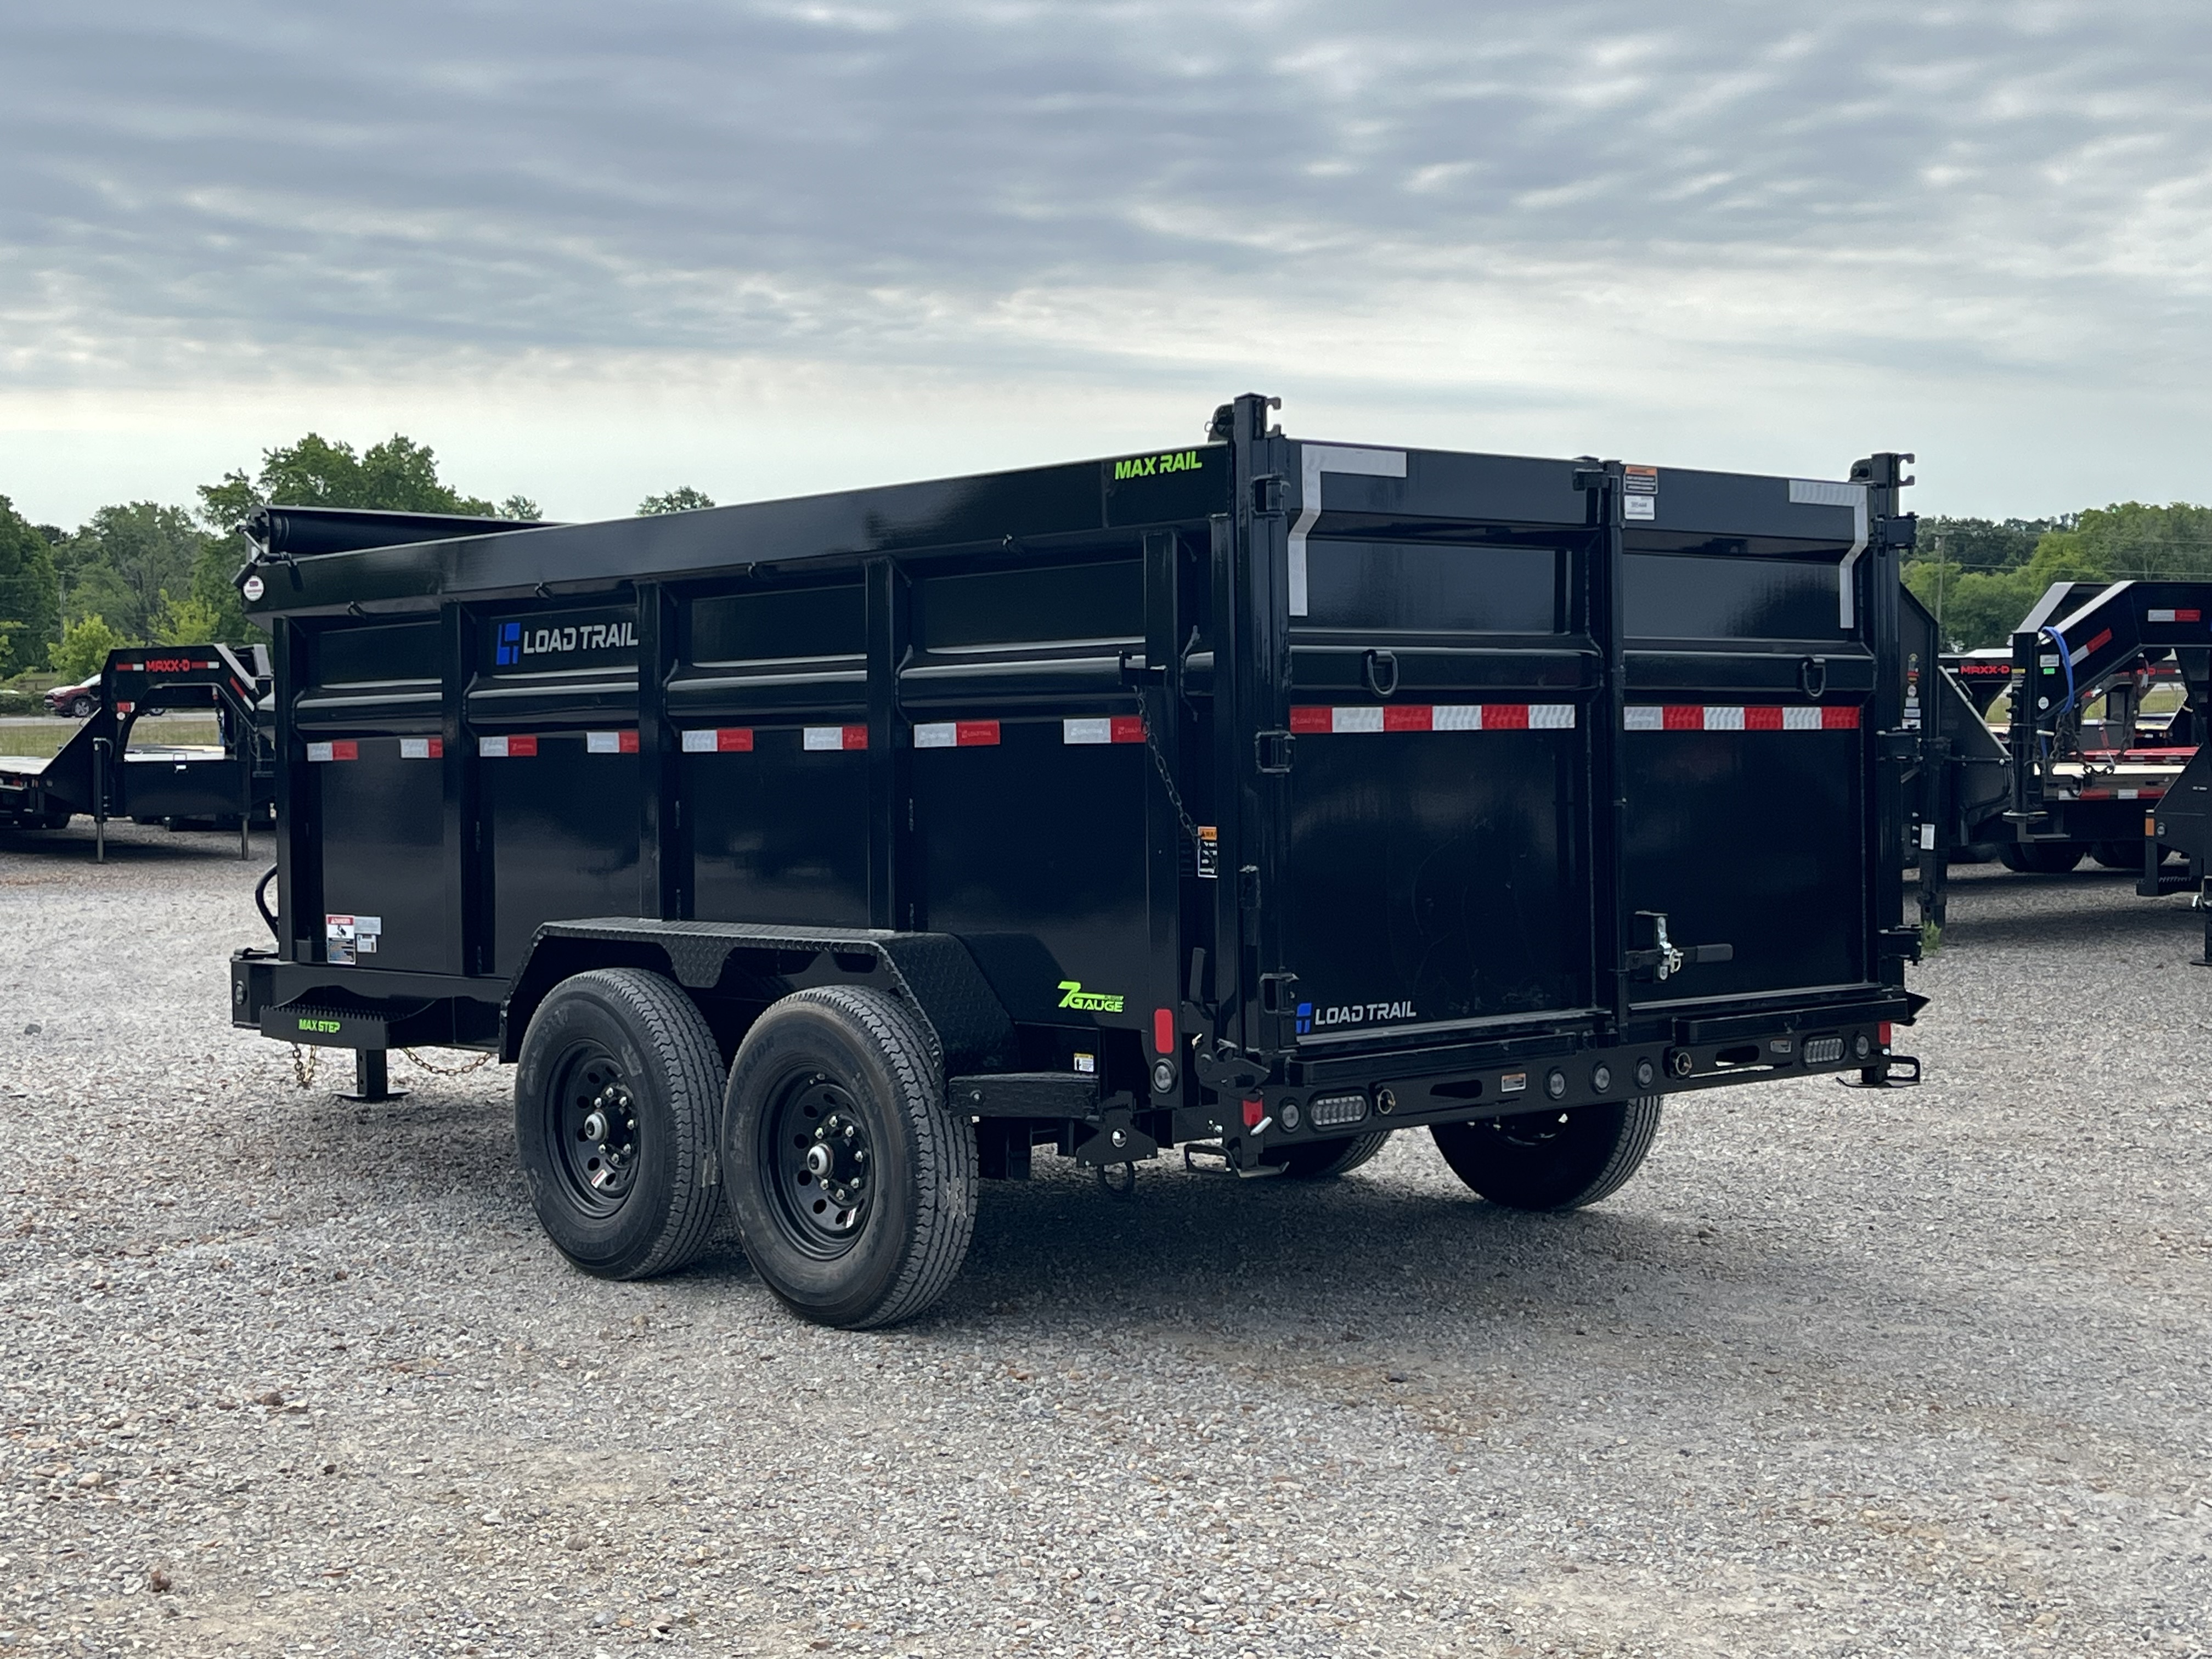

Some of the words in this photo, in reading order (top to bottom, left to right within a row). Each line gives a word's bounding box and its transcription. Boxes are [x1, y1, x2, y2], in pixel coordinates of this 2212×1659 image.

[1115, 456, 1156, 480] MAX
[1159, 450, 1203, 473] RAIL
[523, 627, 577, 654] LOAD
[580, 622, 639, 650] TRAIL
[298, 1019, 318, 1031] MAX
[318, 1020, 341, 1033] STEP
[1315, 1005, 1364, 1025] LOAD
[1367, 1000, 1417, 1021] TRAIL
